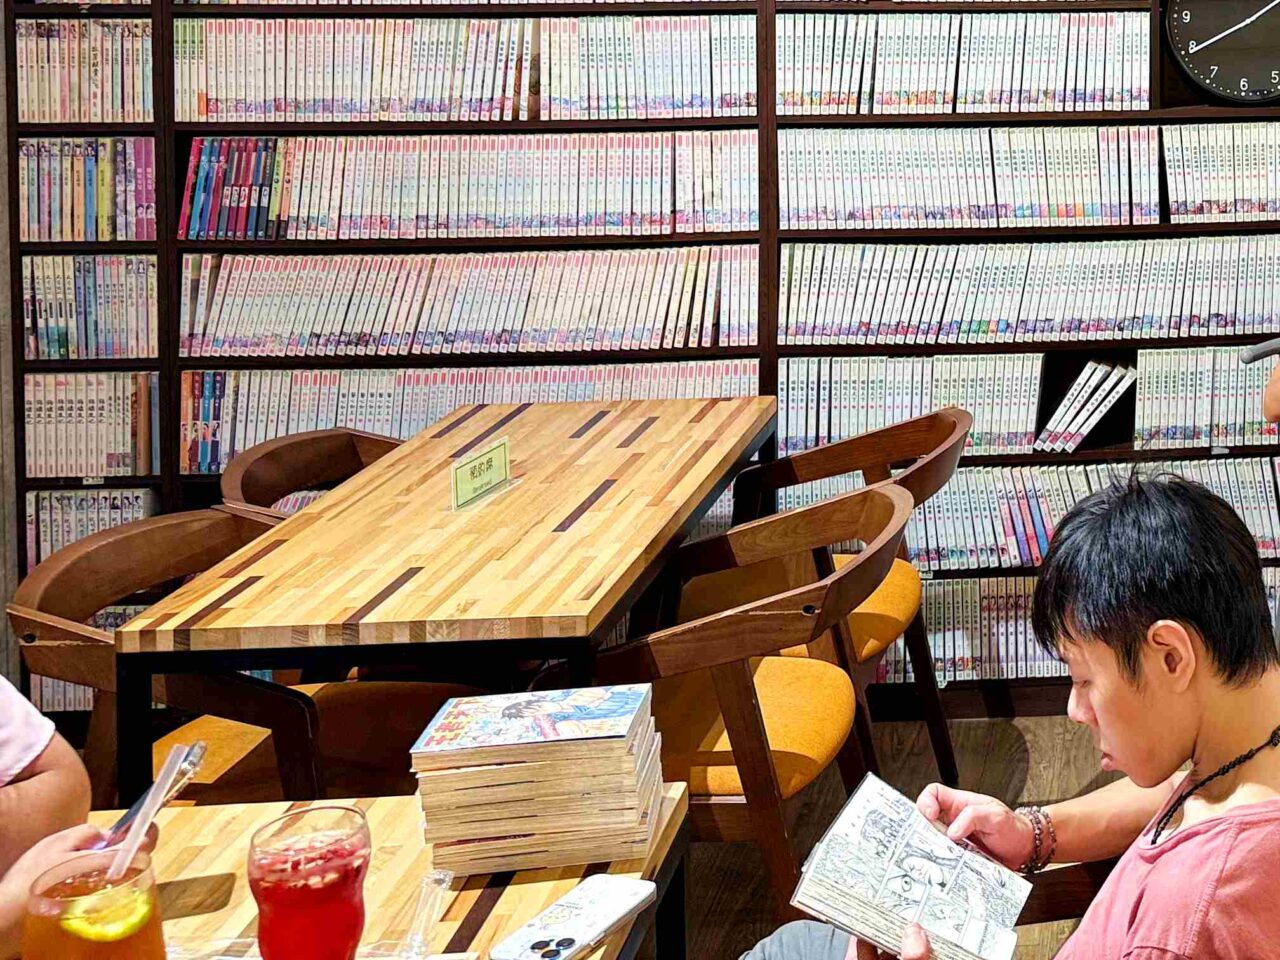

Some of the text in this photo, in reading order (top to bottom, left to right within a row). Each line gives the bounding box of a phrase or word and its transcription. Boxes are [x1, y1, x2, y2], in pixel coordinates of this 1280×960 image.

[1182, 11, 1191, 23] 9
[1210, 66, 1218, 78] 7
[1271, 71, 1280, 83] 5
[1240, 78, 1249, 91] 6
